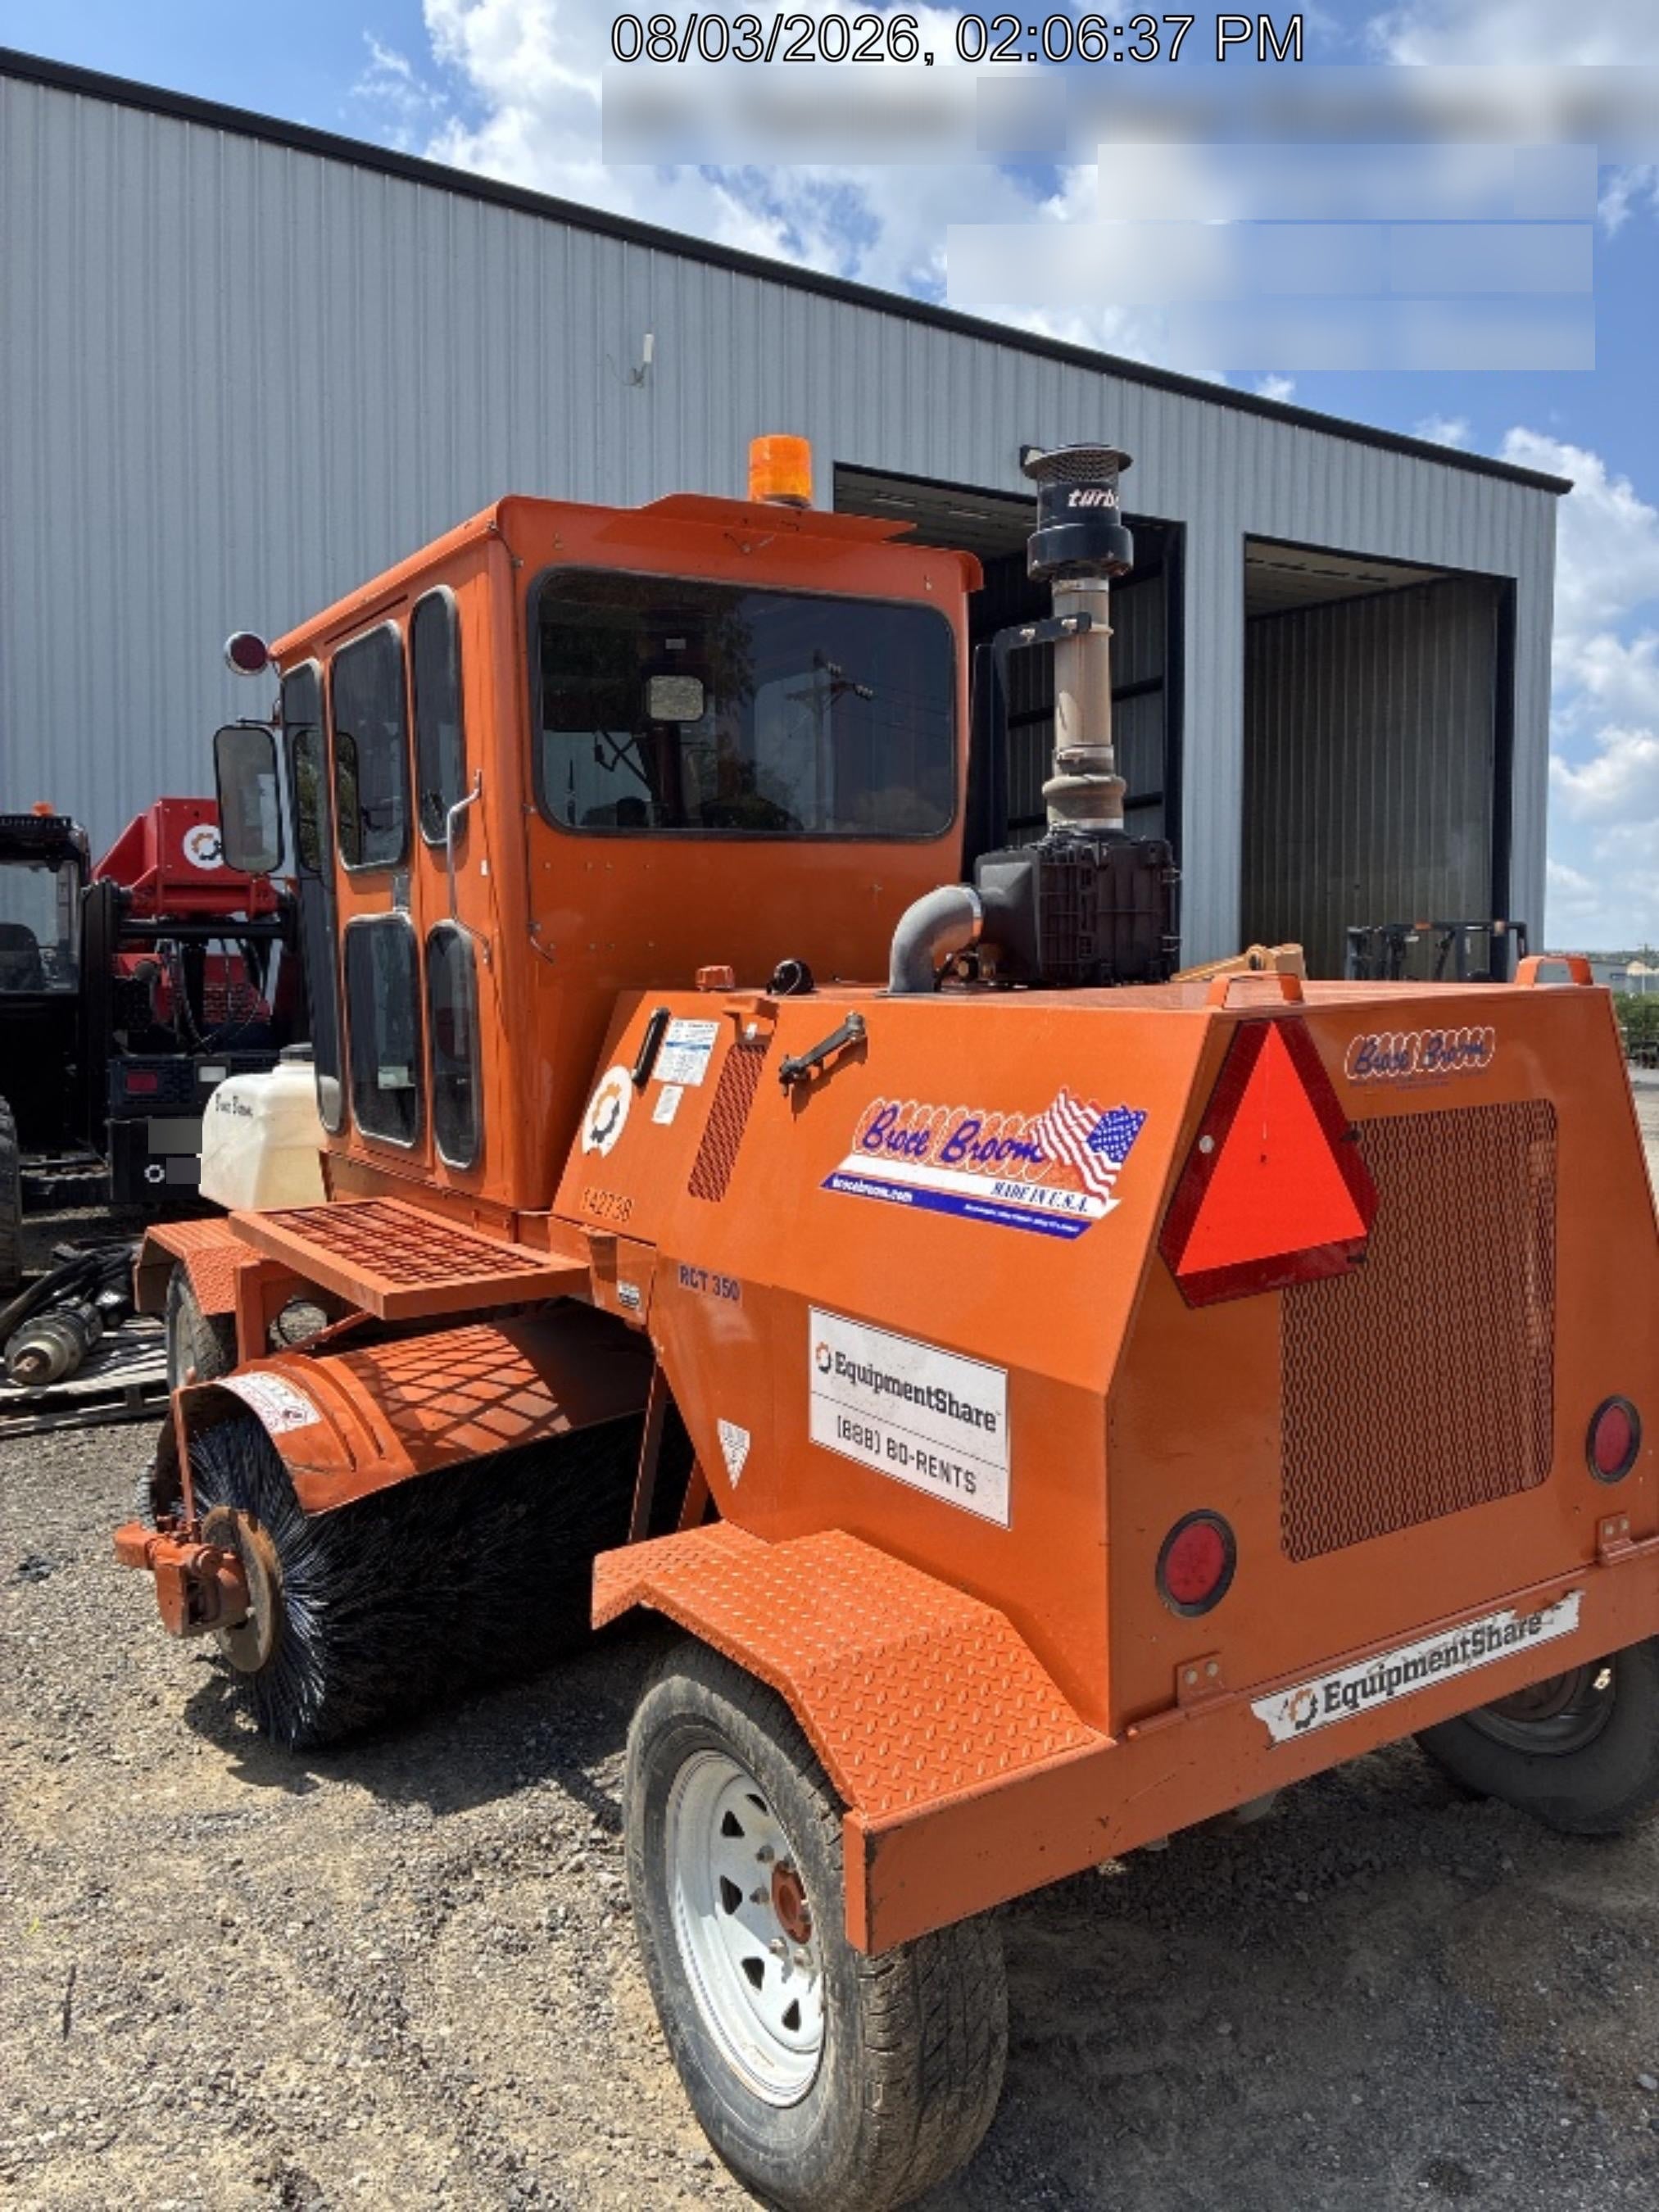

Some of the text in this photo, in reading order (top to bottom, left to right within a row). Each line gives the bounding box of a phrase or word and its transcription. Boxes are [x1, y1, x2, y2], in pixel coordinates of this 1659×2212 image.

[862, 1104, 1046, 1164] Broce Broom
[990, 1181, 1030, 1200] MADE
[1029, 1187, 1049, 1205] IN
[680, 1265, 740, 1301] RCT 350
[834, 1351, 997, 1434] EquipmentShare
[836, 1415, 977, 1495] (888) 80-RENTS
[1323, 1611, 1543, 1713] EquipmentShare
